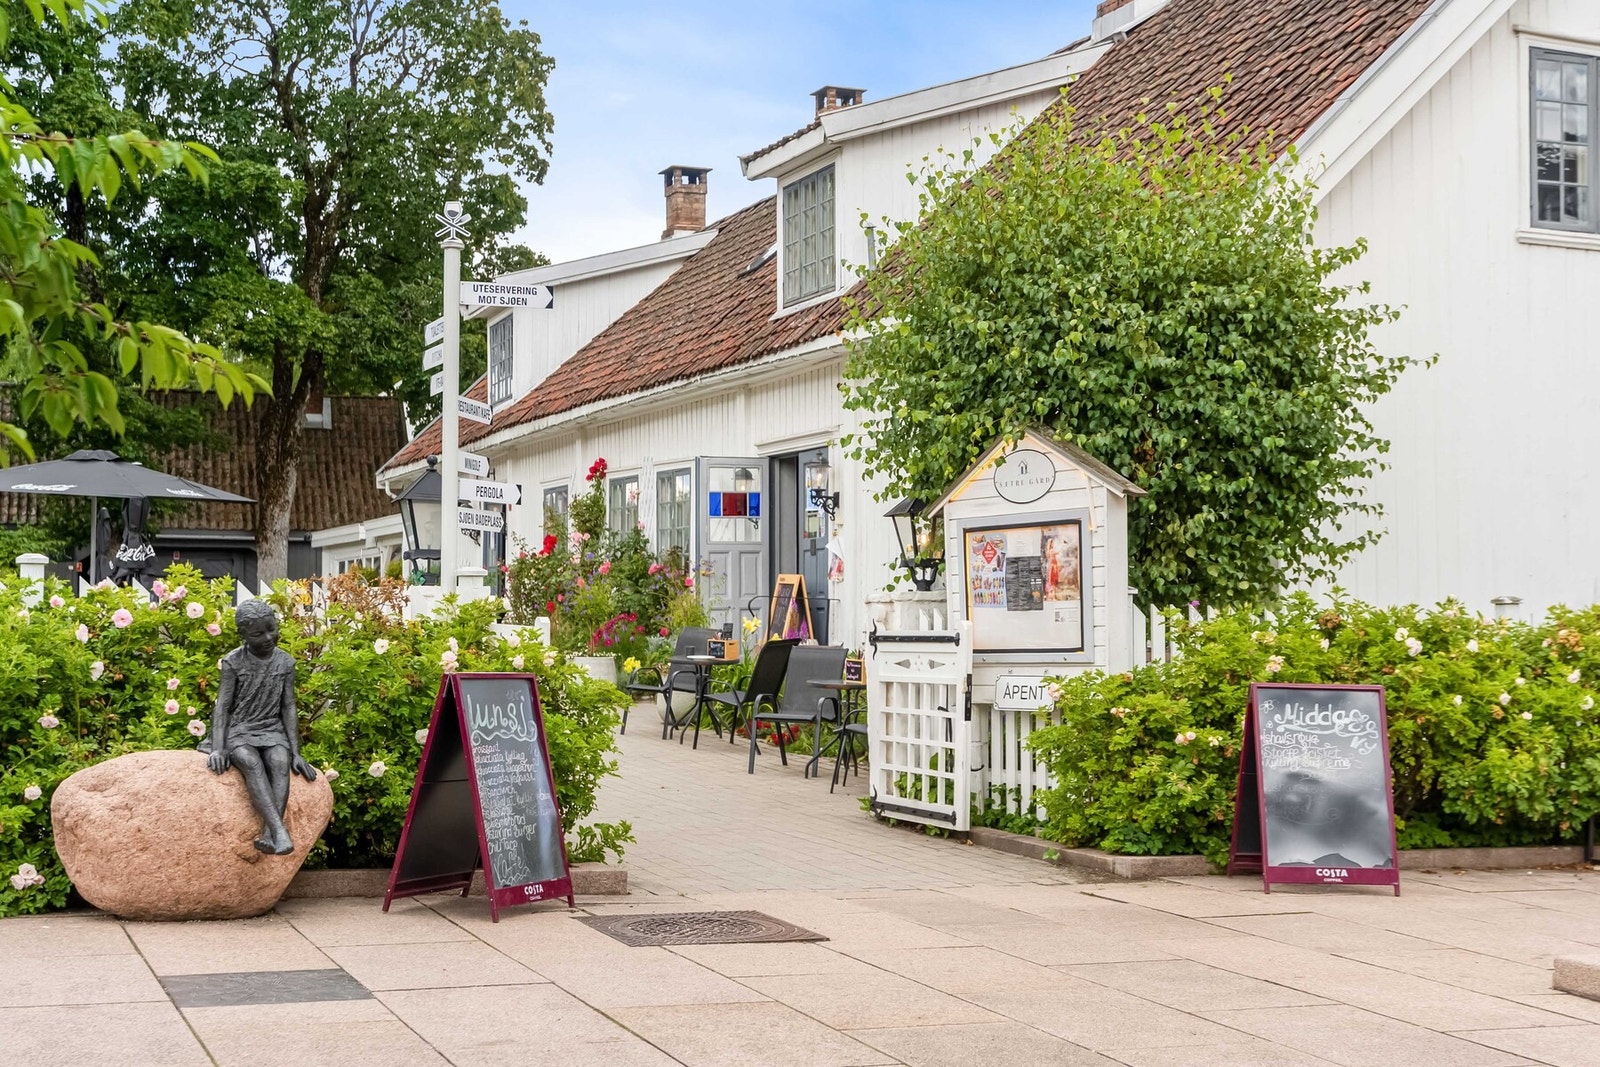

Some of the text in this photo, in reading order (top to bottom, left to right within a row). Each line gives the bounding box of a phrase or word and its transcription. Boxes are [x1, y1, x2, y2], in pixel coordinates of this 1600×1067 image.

[473, 284, 538, 296] UTESERVERING
[478, 295, 527, 306] MOT SJØEN
[475, 485, 504, 499] PERGOLA
[475, 513, 502, 528] BADEPLASS
[1003, 681, 1045, 701] ÅPENT
[1316, 868, 1348, 878] COSTA
[524, 884, 544, 895] COSTA
